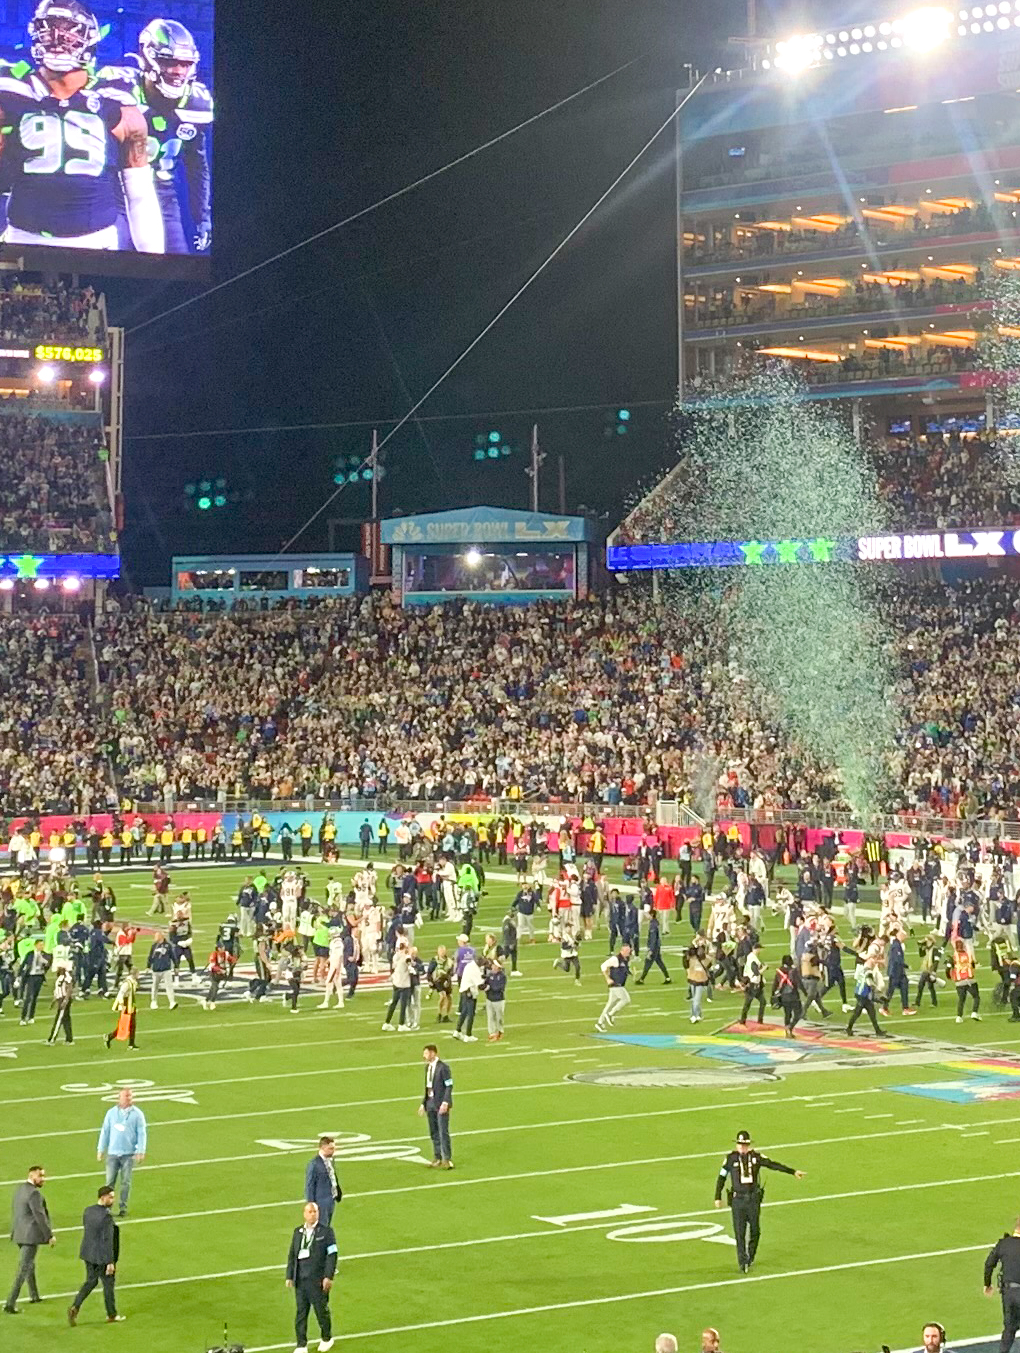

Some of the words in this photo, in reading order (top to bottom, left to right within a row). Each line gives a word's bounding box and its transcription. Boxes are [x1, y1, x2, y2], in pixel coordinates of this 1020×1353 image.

[19, 110, 106, 176] 99
[427, 522, 468, 539] SUPER
[474, 522, 508, 539] BOWL
[515, 521, 570, 539] LX
[858, 536, 902, 560] SUPER
[904, 534, 944, 558] BOWL
[944, 532, 1006, 556] LX
[715, 911, 727, 920] 77
[223, 927, 231, 940] 3
[530, 1203, 725, 1242] 10
